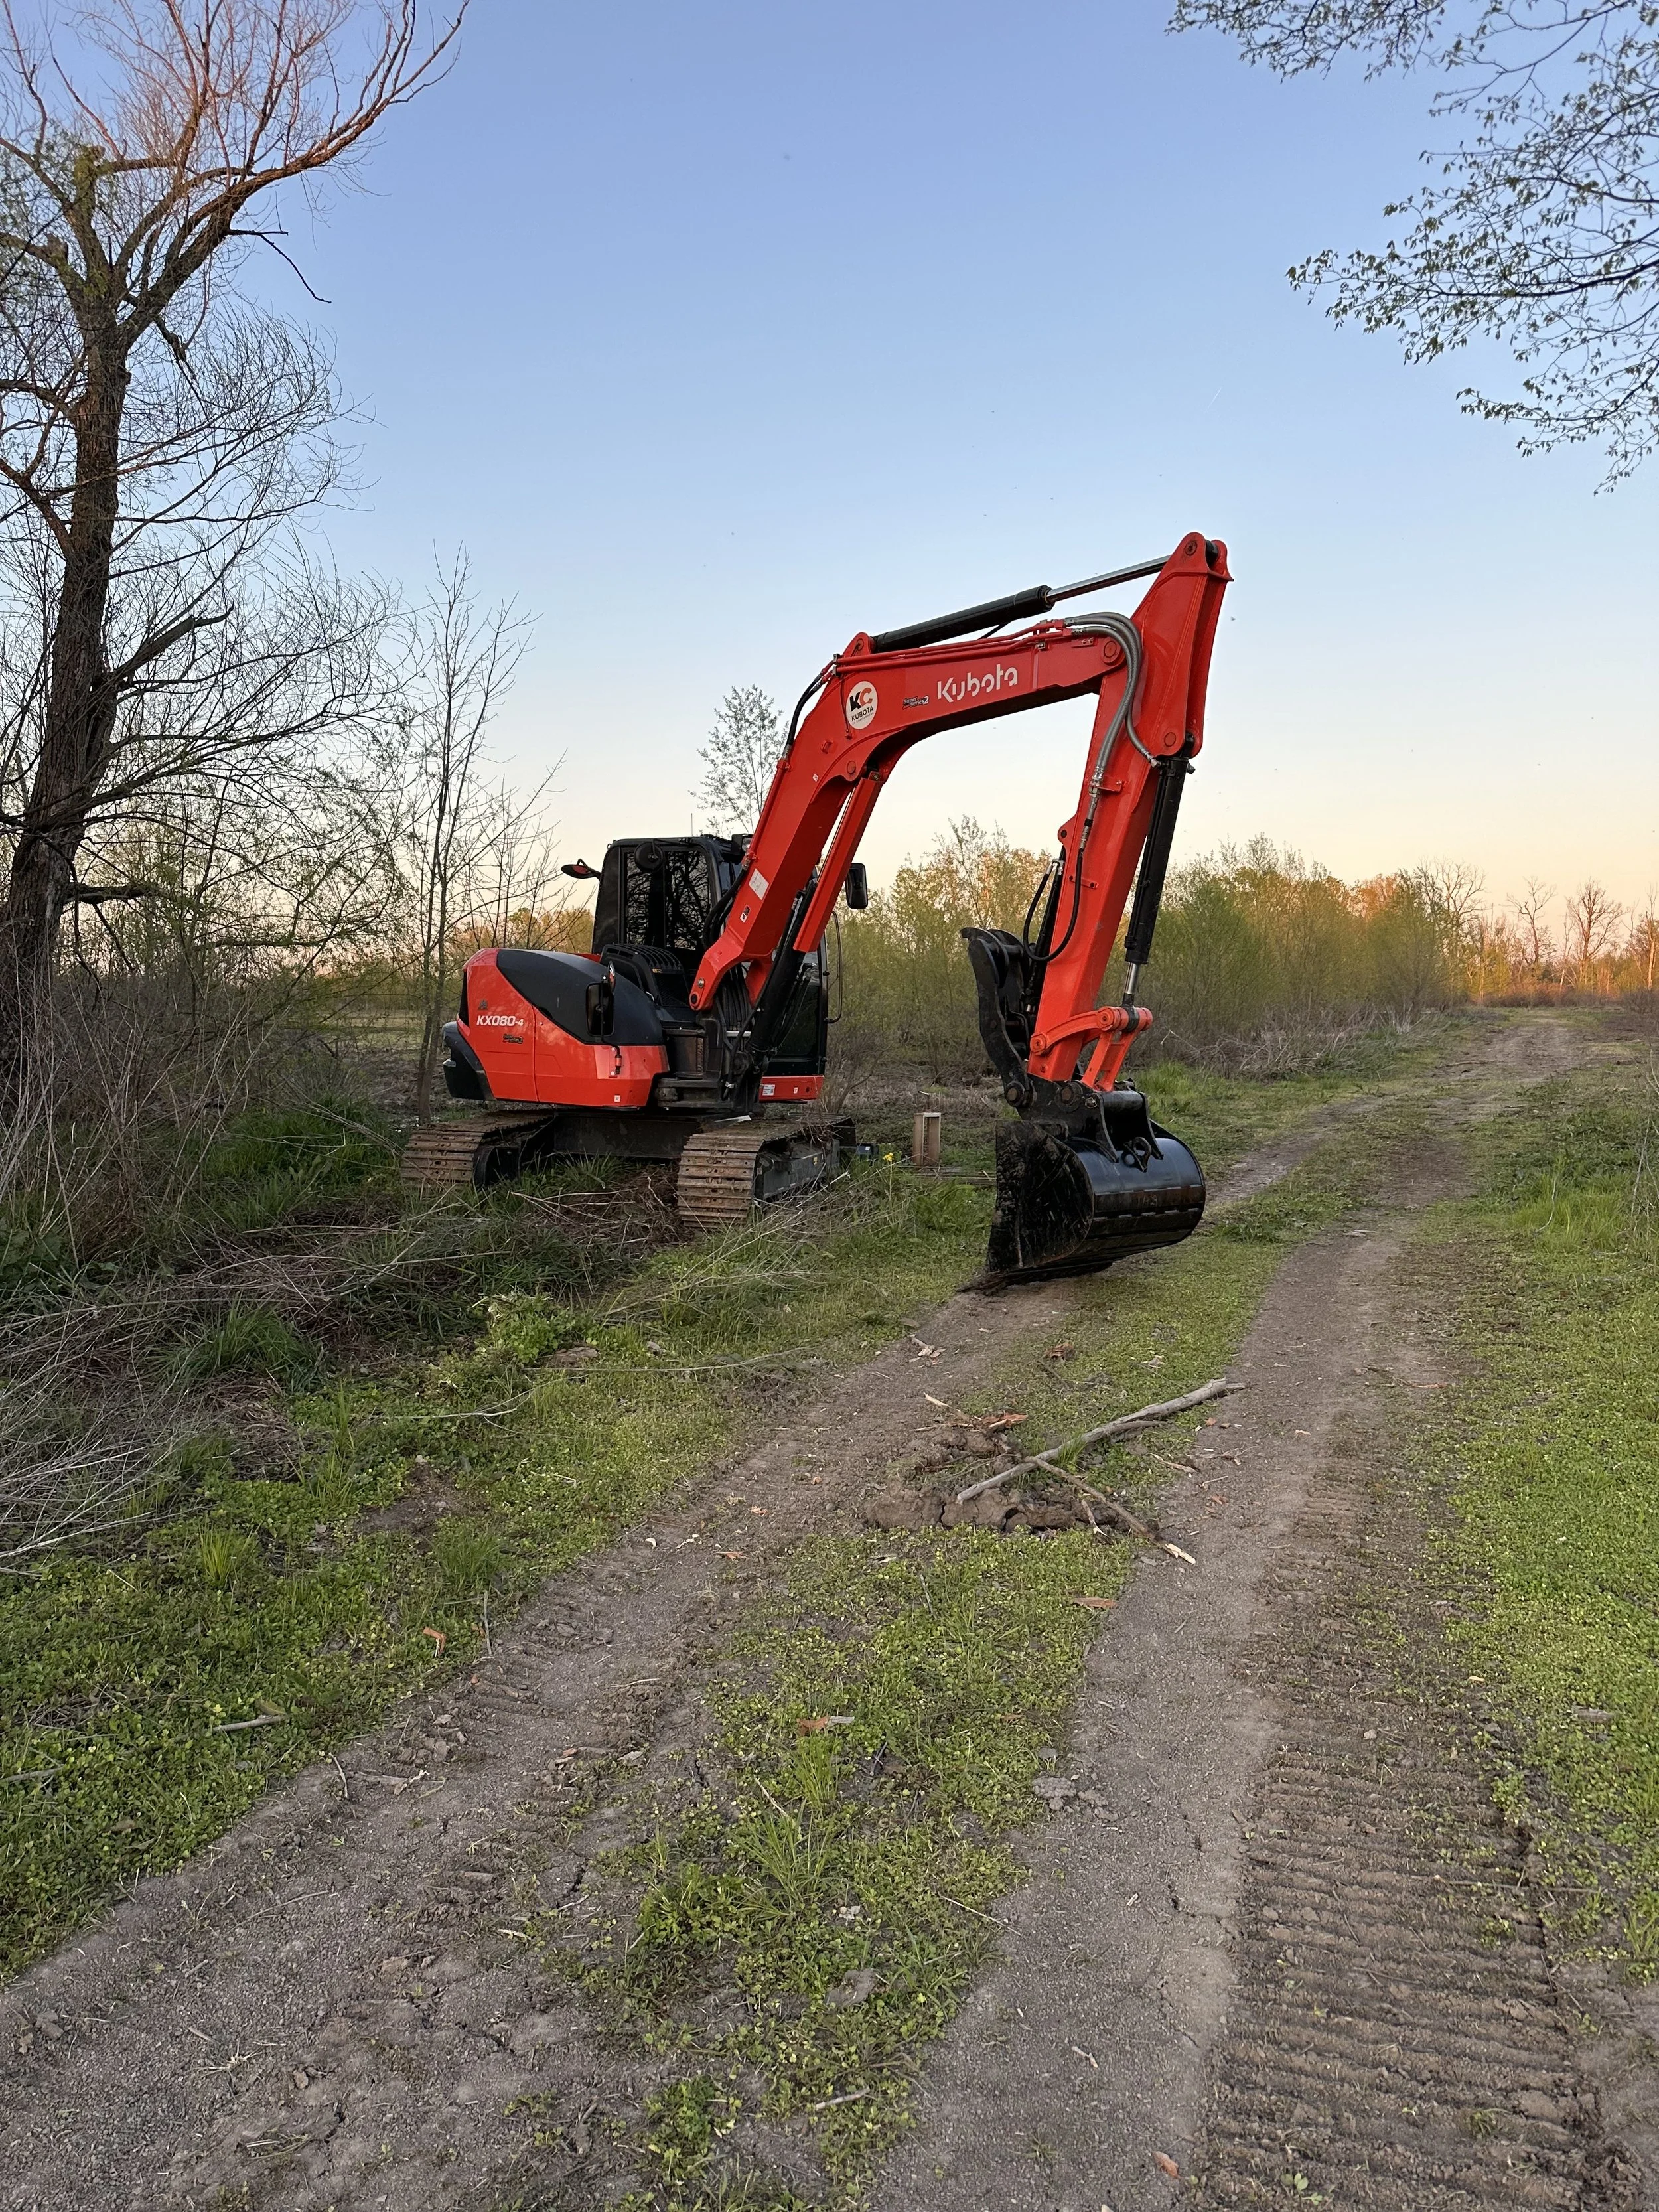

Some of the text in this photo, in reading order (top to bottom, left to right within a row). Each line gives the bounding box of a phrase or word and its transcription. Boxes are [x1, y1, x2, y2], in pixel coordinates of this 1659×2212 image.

[938, 664, 1018, 703] Kubota
[849, 687, 873, 712] KC
[851, 705, 874, 722] KUBOTA
[476, 1015, 524, 1027] KX080-4
